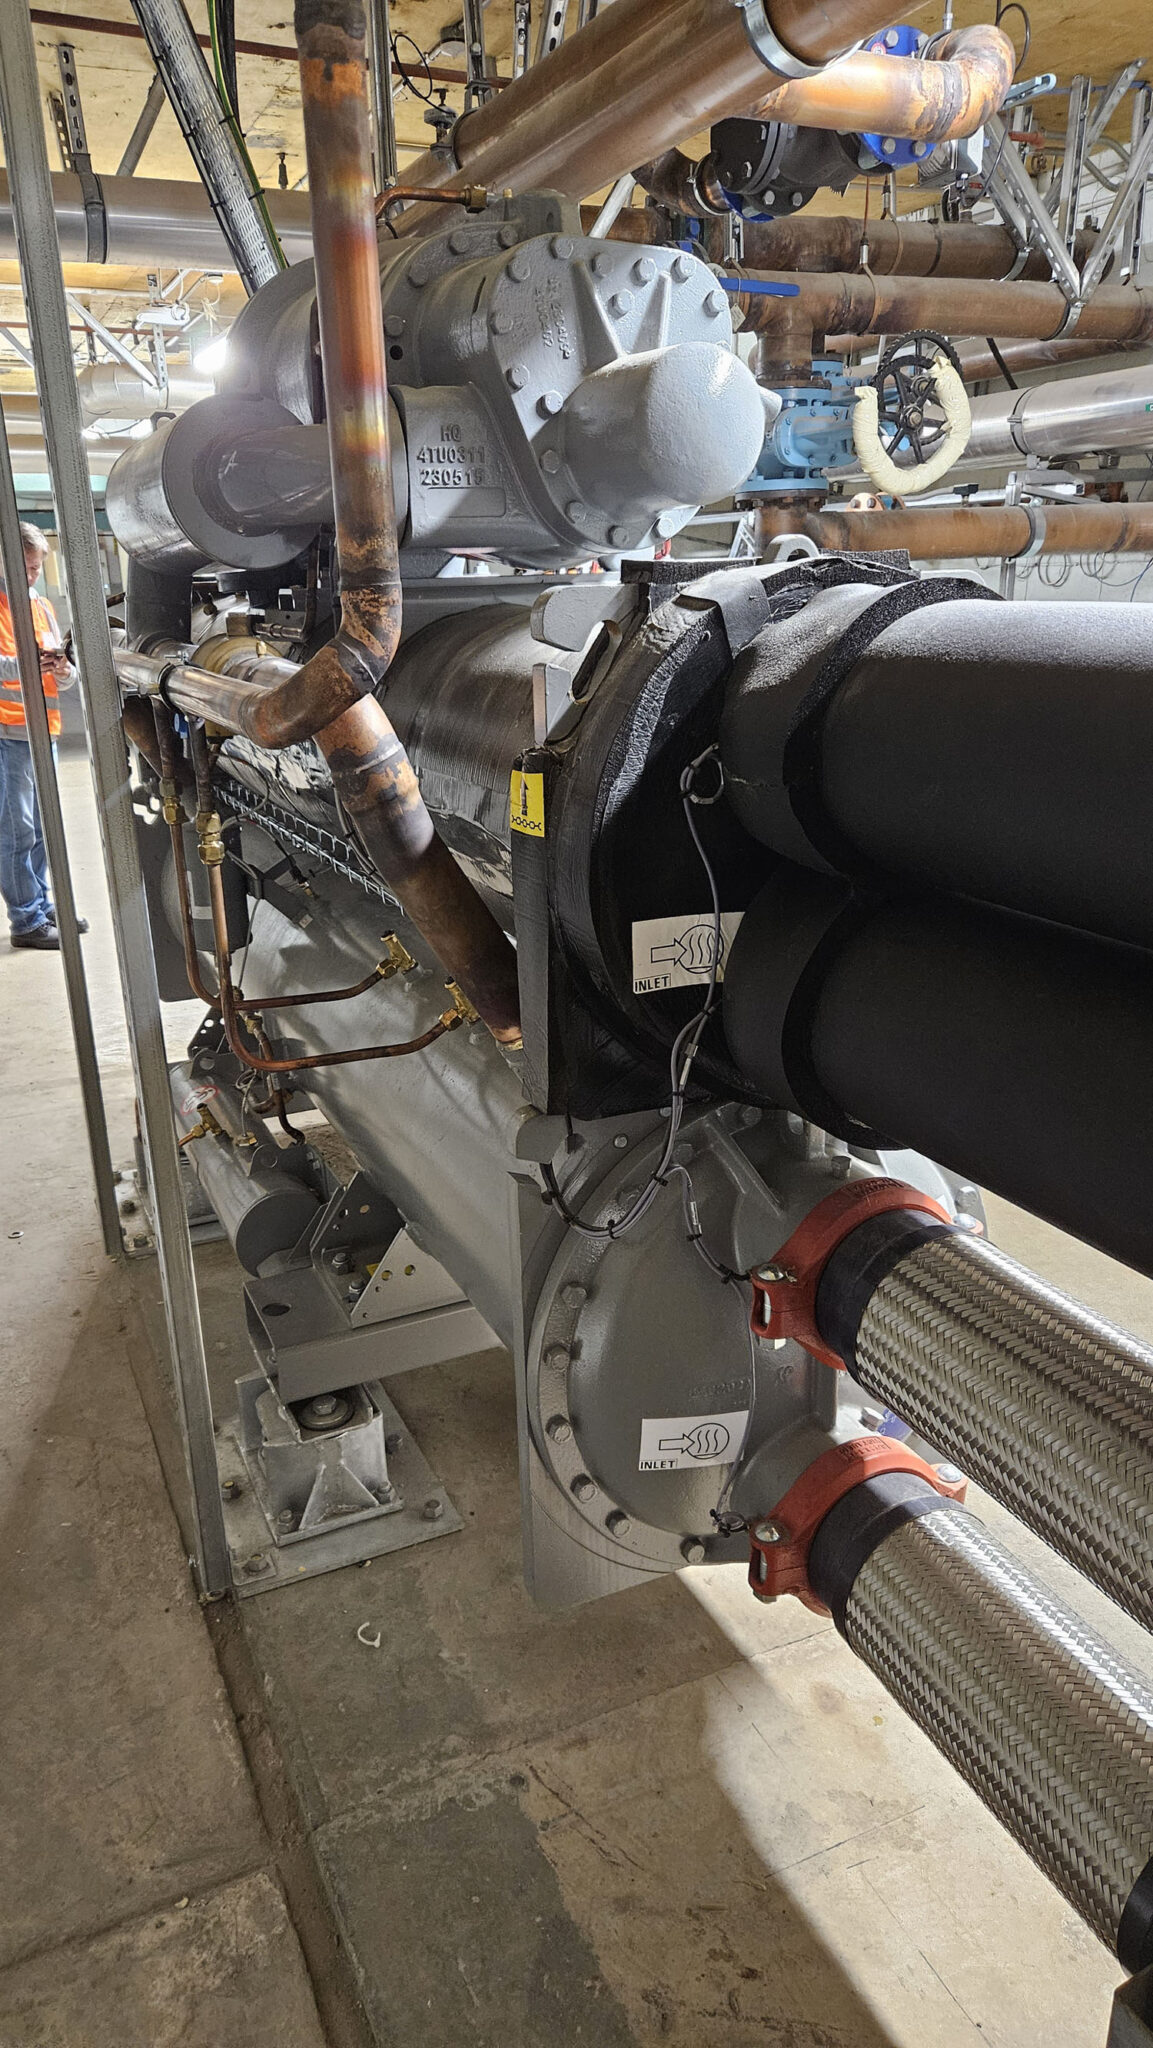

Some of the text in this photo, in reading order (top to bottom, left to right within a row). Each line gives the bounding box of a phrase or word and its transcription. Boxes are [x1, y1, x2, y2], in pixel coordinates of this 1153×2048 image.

[440, 424, 462, 442] HQ
[416, 445, 486, 464] 4TU0311
[634, 975, 670, 993] INLET
[640, 1460, 676, 1470] INLET
